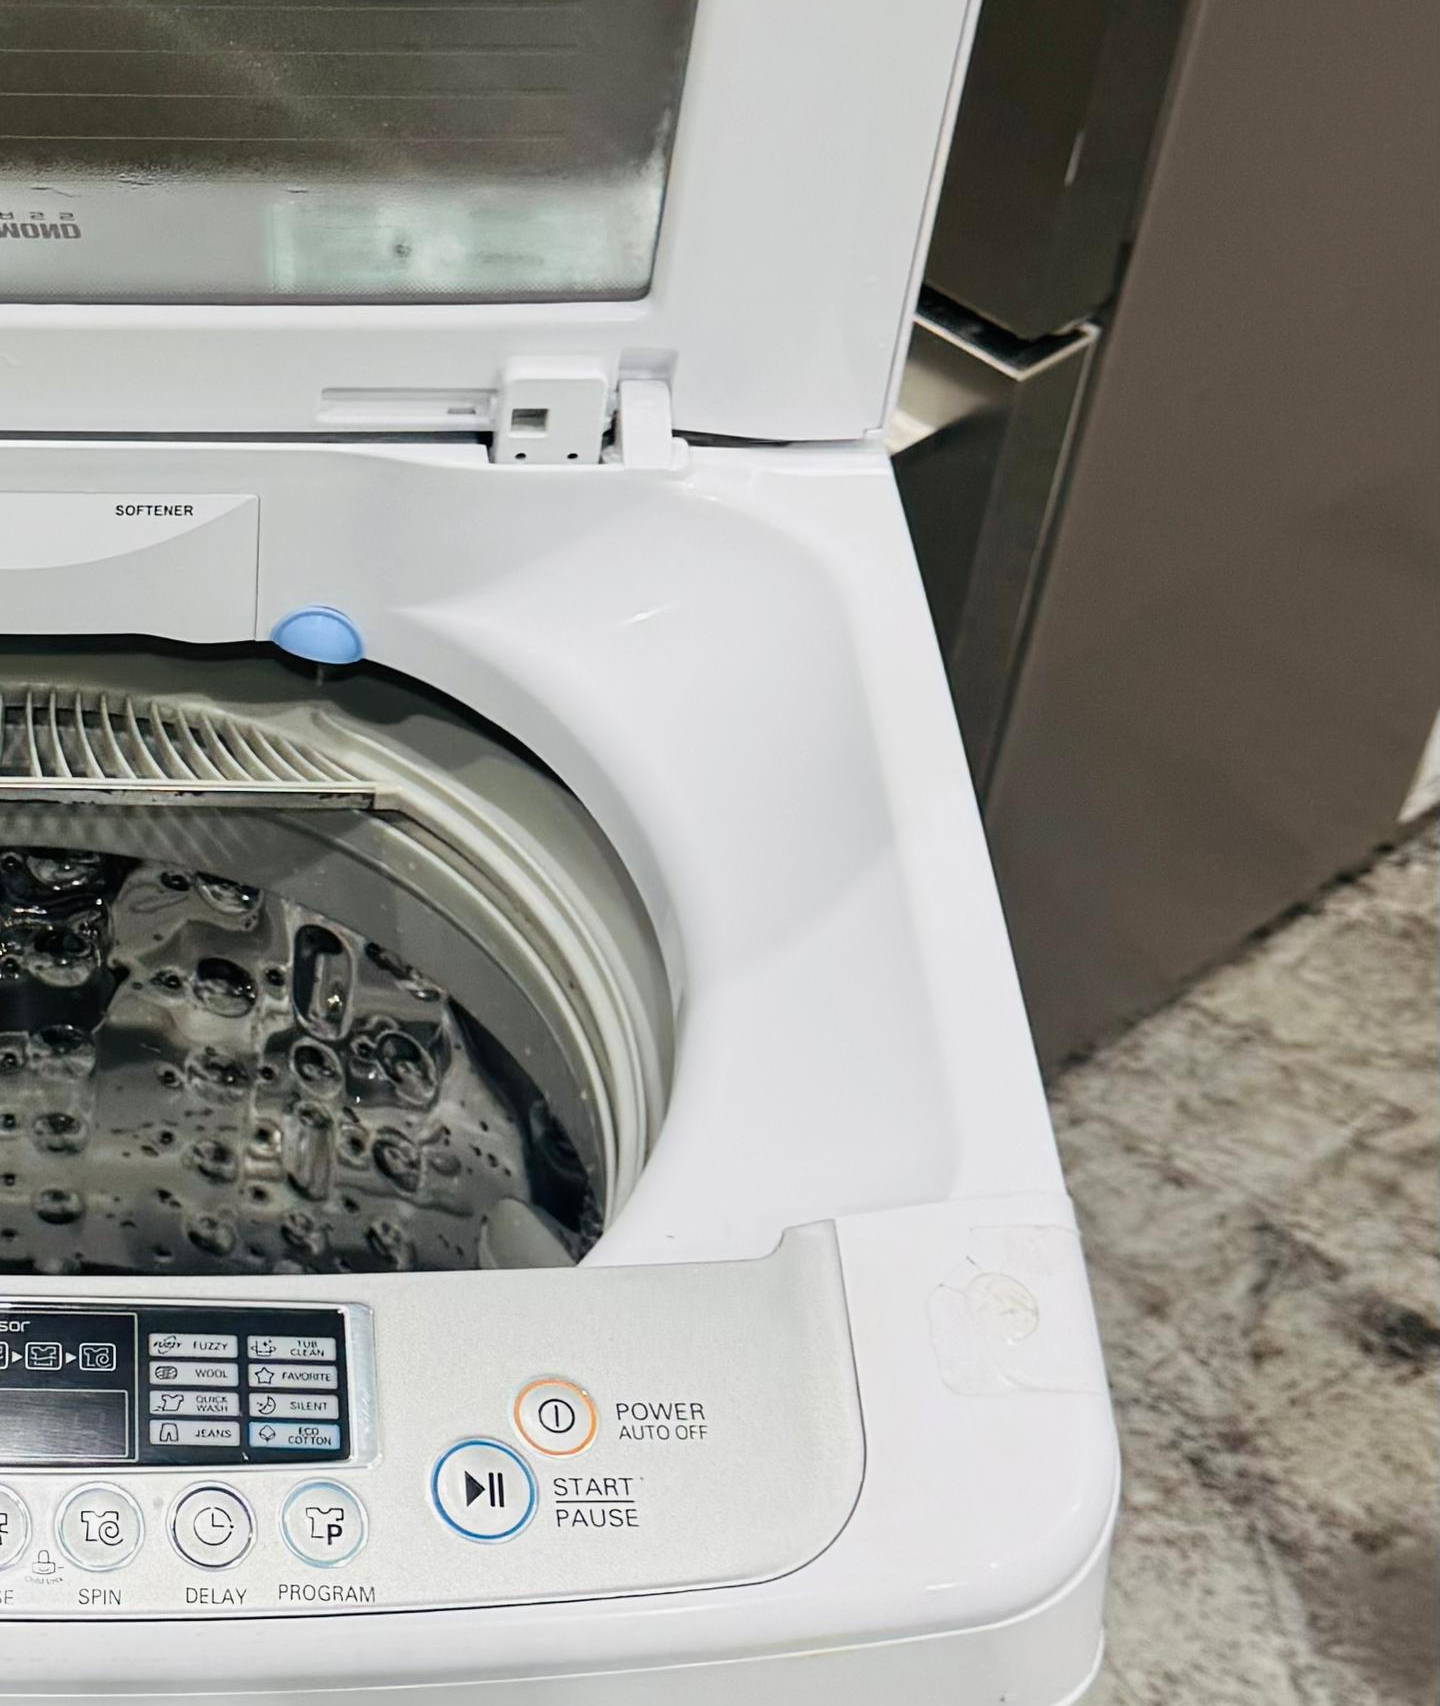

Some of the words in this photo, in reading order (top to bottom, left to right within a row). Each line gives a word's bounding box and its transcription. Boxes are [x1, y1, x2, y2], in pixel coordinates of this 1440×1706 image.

[115, 504, 194, 517] SOFTENER
[192, 1339, 228, 1351] FUZZY
[289, 1348, 325, 1357] CLEAN
[195, 1368, 228, 1379] WOOL
[281, 1371, 332, 1383] FAVORITE
[195, 1404, 228, 1412] WASH
[289, 1400, 328, 1411] SILENT
[615, 1402, 706, 1421] POWER
[194, 1428, 232, 1438] JEANS
[619, 1424, 672, 1440] AUTO
[675, 1424, 709, 1440] OFF
[288, 1436, 332, 1446] COTTON
[553, 1477, 633, 1496] START
[555, 1508, 640, 1528] PAUSE
[77, 1588, 122, 1605] SPIN
[185, 1587, 248, 1605] DELAY
[278, 1584, 376, 1603] PROGRAM
